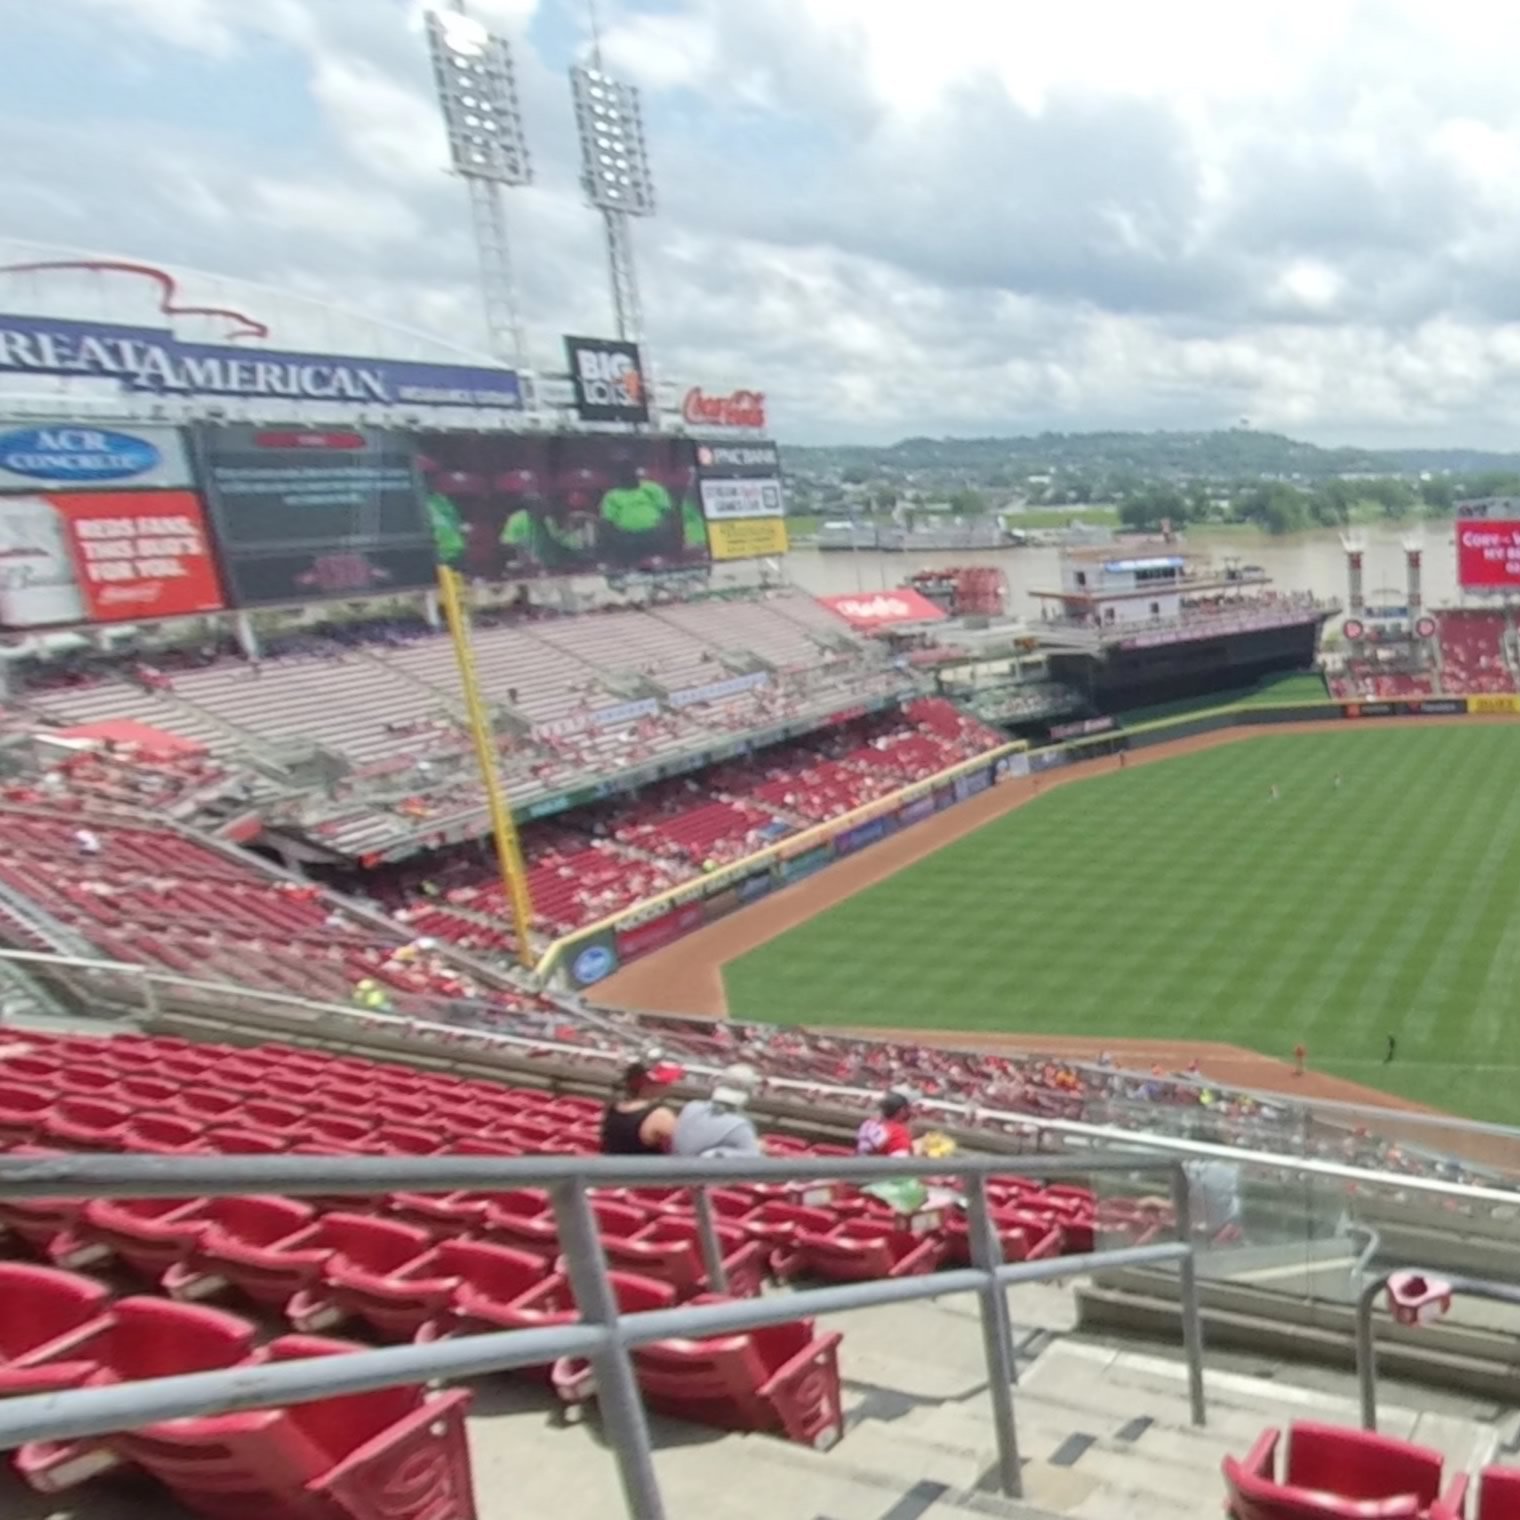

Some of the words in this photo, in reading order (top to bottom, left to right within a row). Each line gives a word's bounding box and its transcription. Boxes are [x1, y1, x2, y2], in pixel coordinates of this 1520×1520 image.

[137, 346, 389, 399] AMERICAN
[576, 349, 632, 381] BIG
[683, 386, 767, 428] Coca-Cola
[37, 430, 111, 451] ACR
[6, 453, 134, 470] CONCRETE
[74, 519, 133, 539] REDS
[86, 562, 134, 582] FOR
